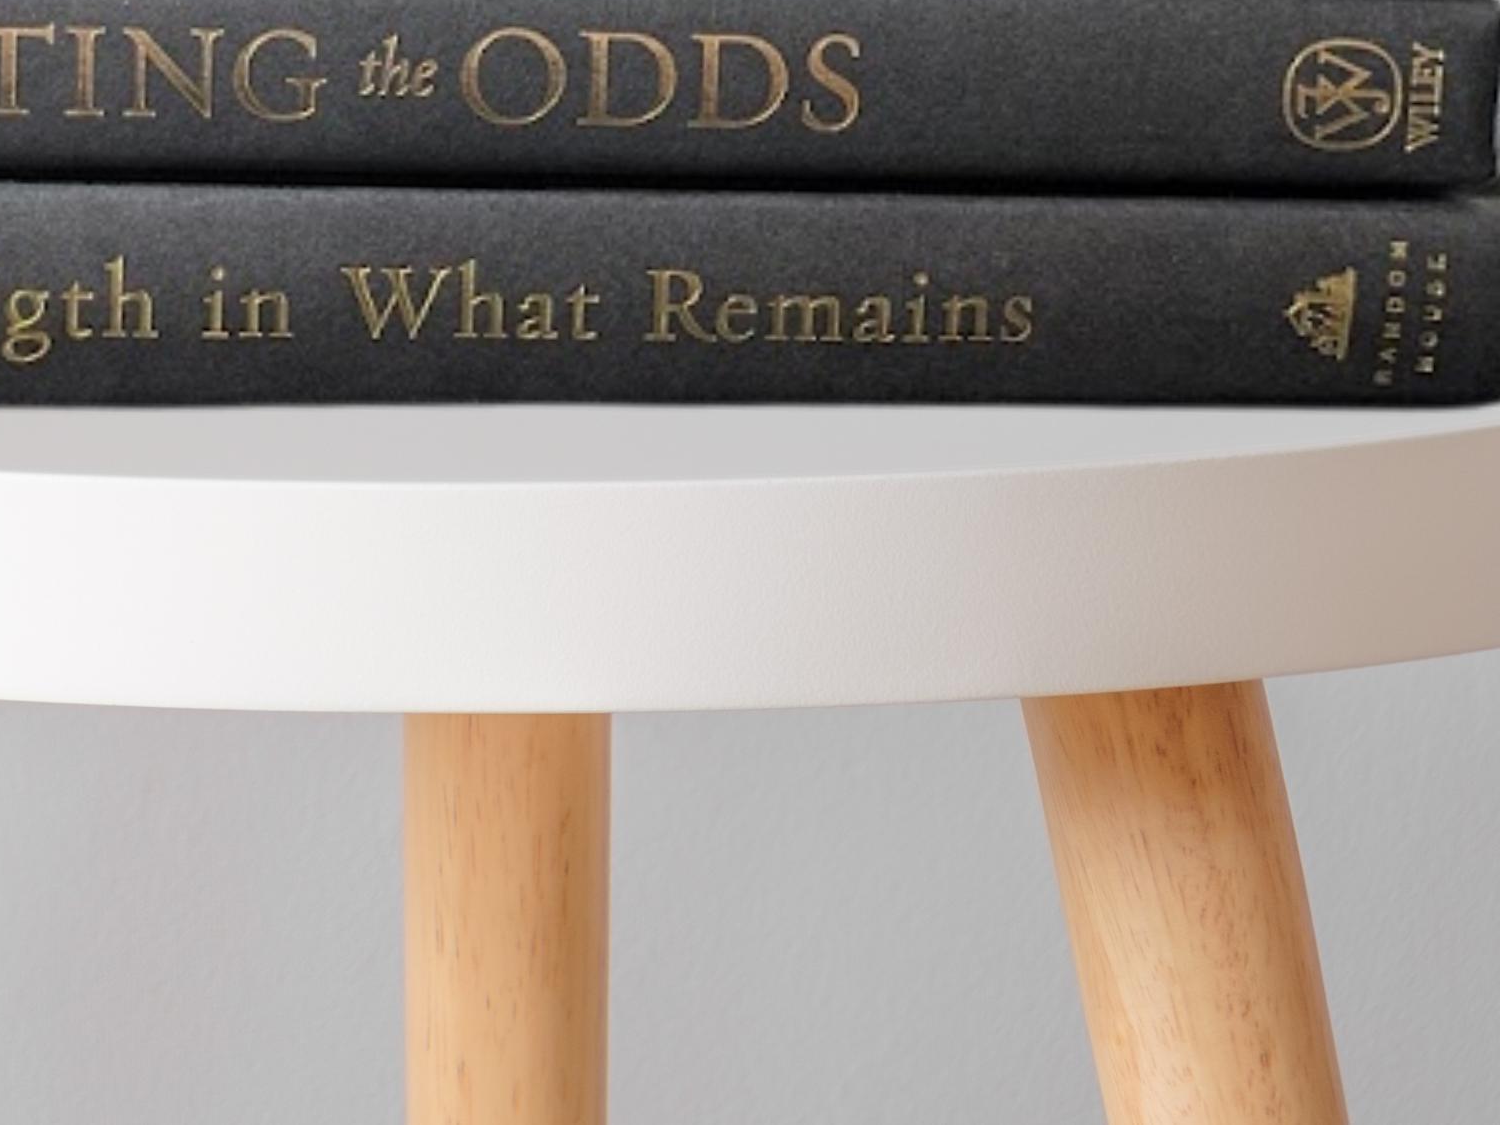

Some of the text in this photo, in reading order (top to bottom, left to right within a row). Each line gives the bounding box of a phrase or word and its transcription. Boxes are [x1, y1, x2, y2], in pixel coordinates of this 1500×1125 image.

[356, 35, 441, 99] the
[460, 25, 863, 133] ODDS
[1405, 41, 1446, 154] WILEY
[200, 265, 294, 343] in
[340, 263, 600, 345] What
[645, 267, 1037, 347] Remains
[1373, 240, 1410, 387] RANDOM
[1414, 252, 1448, 373] HOUSE
